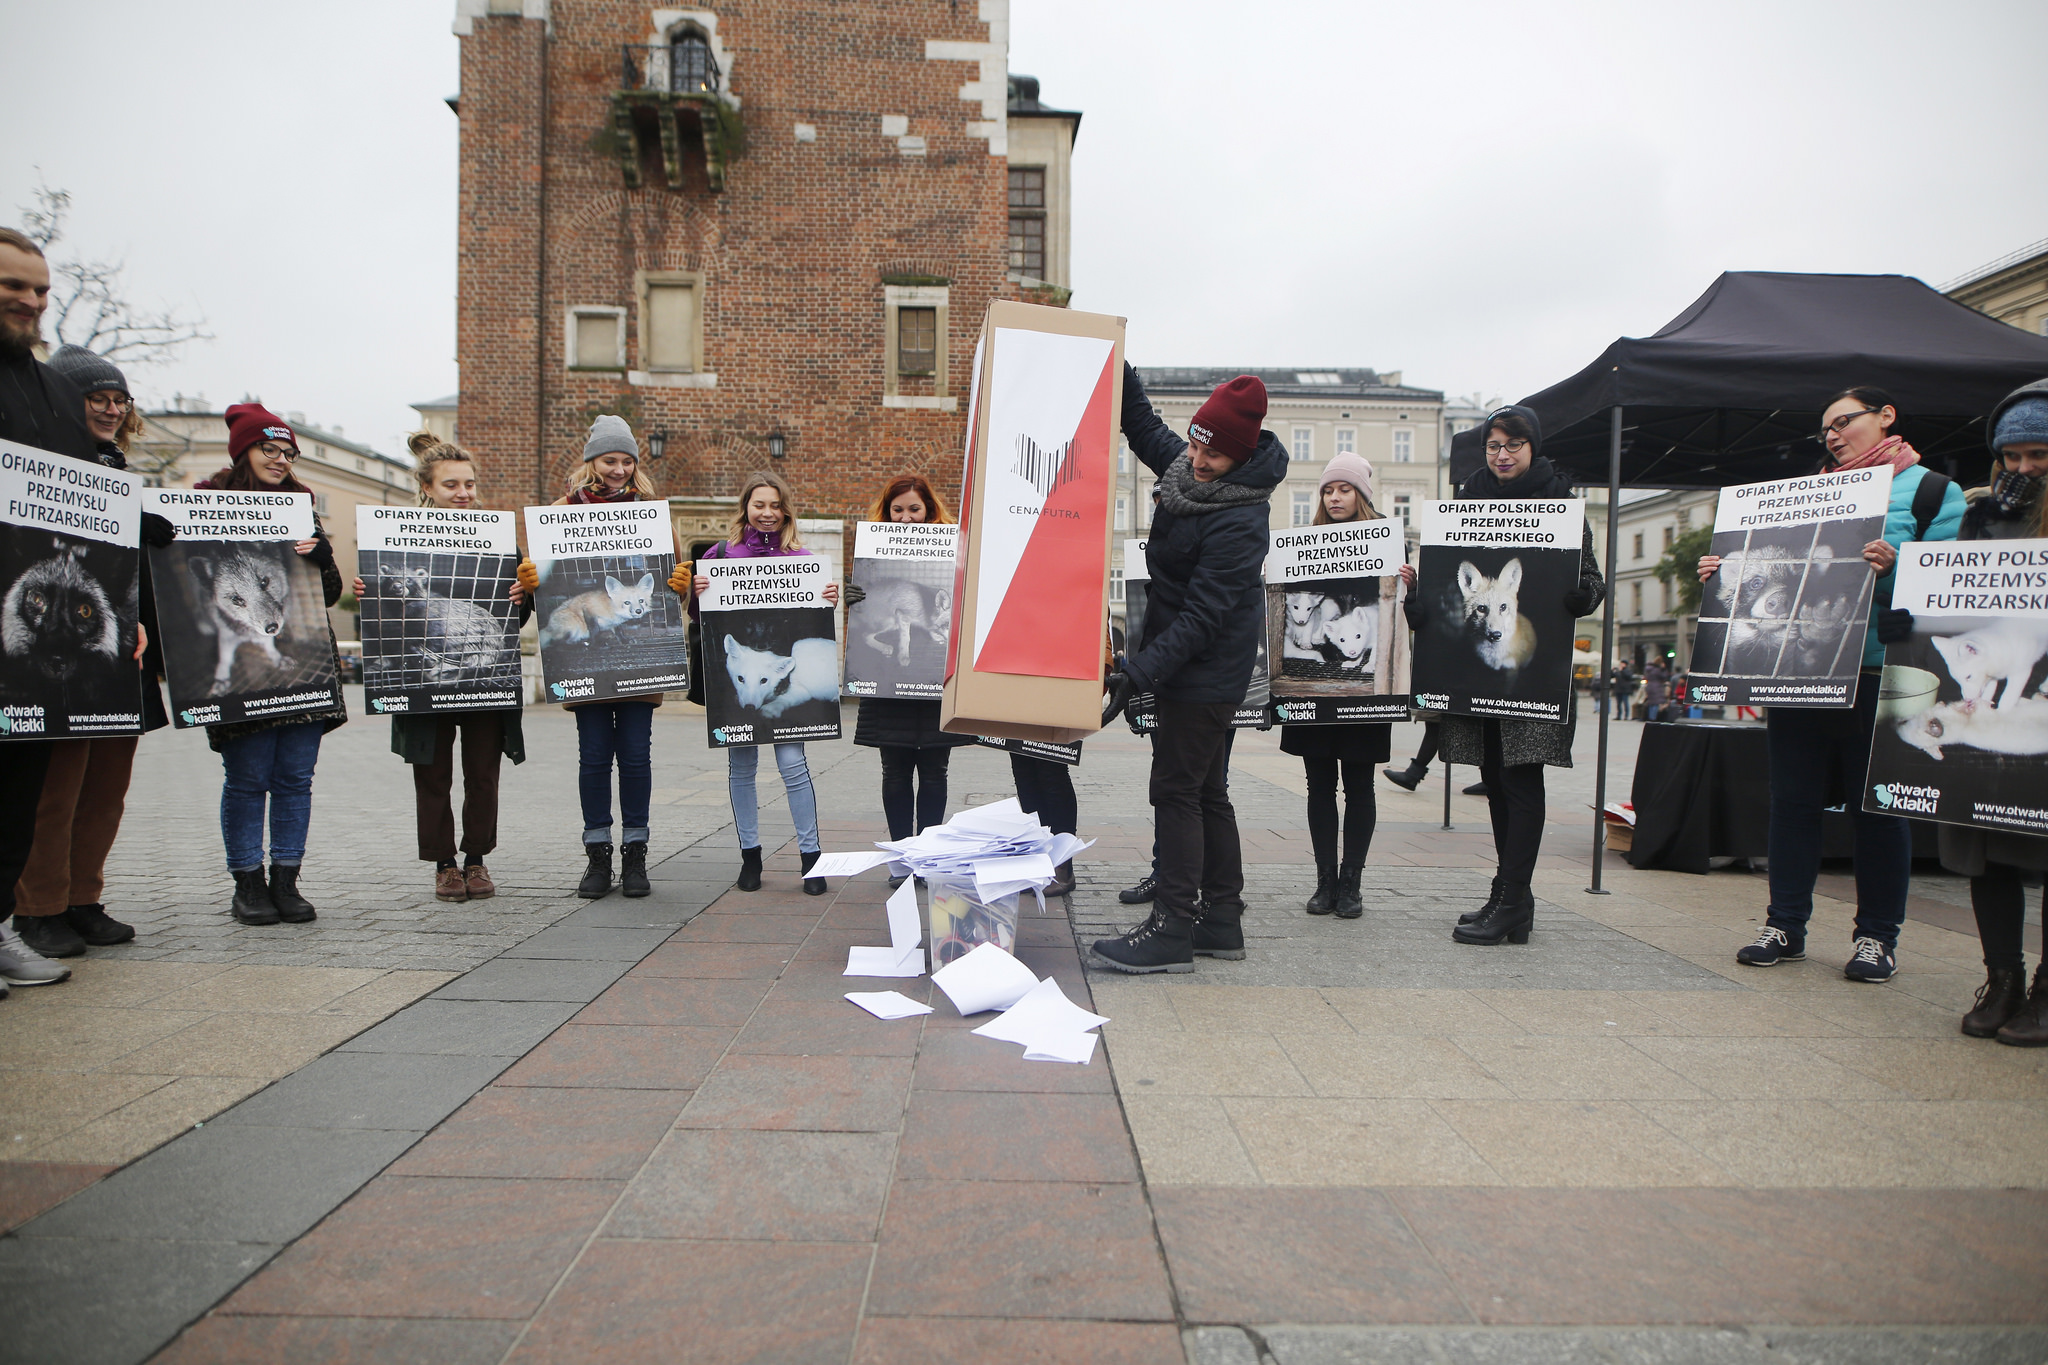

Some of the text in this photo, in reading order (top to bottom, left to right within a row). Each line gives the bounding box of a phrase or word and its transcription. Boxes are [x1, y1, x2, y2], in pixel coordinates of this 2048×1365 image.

[2, 453, 130, 497] OFIARY POLSKIEGO
[1736, 471, 1872, 499] OFIARY POLSKIEGO
[27, 481, 107, 512] PRZEMYSŁU
[159, 493, 294, 506] OFIARY POLSKIEGO
[1757, 490, 1842, 510] PRZEMYSŁU
[1008, 505, 1081, 520] CENA FUTRA
[1438, 503, 1567, 514] OFIARY POLSKIEGO
[1740, 503, 1857, 526] FUTRZARSKIEGO
[9, 500, 120, 535] FUTRZARSKIEGO
[189, 509, 272, 521] PRZEMYSŁU
[374, 509, 500, 523] OFIARY POLSKIEGO
[539, 508, 658, 525] OFIARY POLSKIEGO
[1461, 518, 1540, 528] PRZEMYSŁU
[174, 525, 289, 536] FUTRZARSKIEGO
[400, 524, 477, 536] PRZEMYSŁU
[563, 524, 637, 539] PRZEMYSŁU
[870, 524, 958, 536] OFIARY POLSKIE
[384, 537, 492, 549] FUTRZARSKIEGO
[888, 536, 951, 546] PRZEMYSŁU
[1276, 526, 1391, 548] OFIARY POLSKIEGO
[1445, 532, 1555, 543] FUTRZARSKIEGO
[551, 537, 653, 554] FUTRZARSKIEGO
[1297, 544, 1369, 561] PRZEMYSŁU
[1919, 552, 1992, 567] OFIARY
[710, 562, 820, 577] OFIARY POLSKIEGO
[1285, 558, 1384, 578] FUTRZARSKIEGO
[732, 578, 800, 591] PRZEMYSŁU
[1951, 572, 2047, 588] PRZEMYS
[720, 591, 814, 606] FUTRZARSKIEGO
[559, 676, 595, 688] otwarte
[615, 673, 686, 687] www.otwarteklatki.pl
[565, 685, 595, 698] klatki
[856, 686, 877, 695] klatki
[1699, 684, 1728, 693] otwarte
[1750, 685, 1847, 696] www.otwarteklatki.pl
[243, 690, 331, 708] www.otwarteklatki.pl
[379, 695, 409, 704] otwarte
[431, 691, 516, 702] www.otwarteklatki.pl
[1422, 692, 1450, 701] otwarte
[1701, 692, 1726, 702] klatki
[3, 704, 45, 717] otwarte
[187, 704, 220, 715] otwarte
[384, 702, 409, 712] klatki
[1283, 701, 1316, 710] otwarte
[1336, 704, 1407, 713] www.otwarteklatki.pl
[1426, 699, 1449, 710] klatki
[1471, 696, 1560, 713] www.otwarteklatki.pl
[68, 713, 140, 723] www.otwarteklatki.pl
[194, 712, 221, 724] klatki
[1288, 710, 1316, 720] klatki
[11, 718, 45, 732] klatki
[720, 723, 754, 733] otwarte
[773, 723, 838, 735] www.otwarteklatki.pl
[726, 731, 753, 743] klatki
[1887, 782, 1941, 799] otwarte
[1892, 794, 1937, 814] klatki
